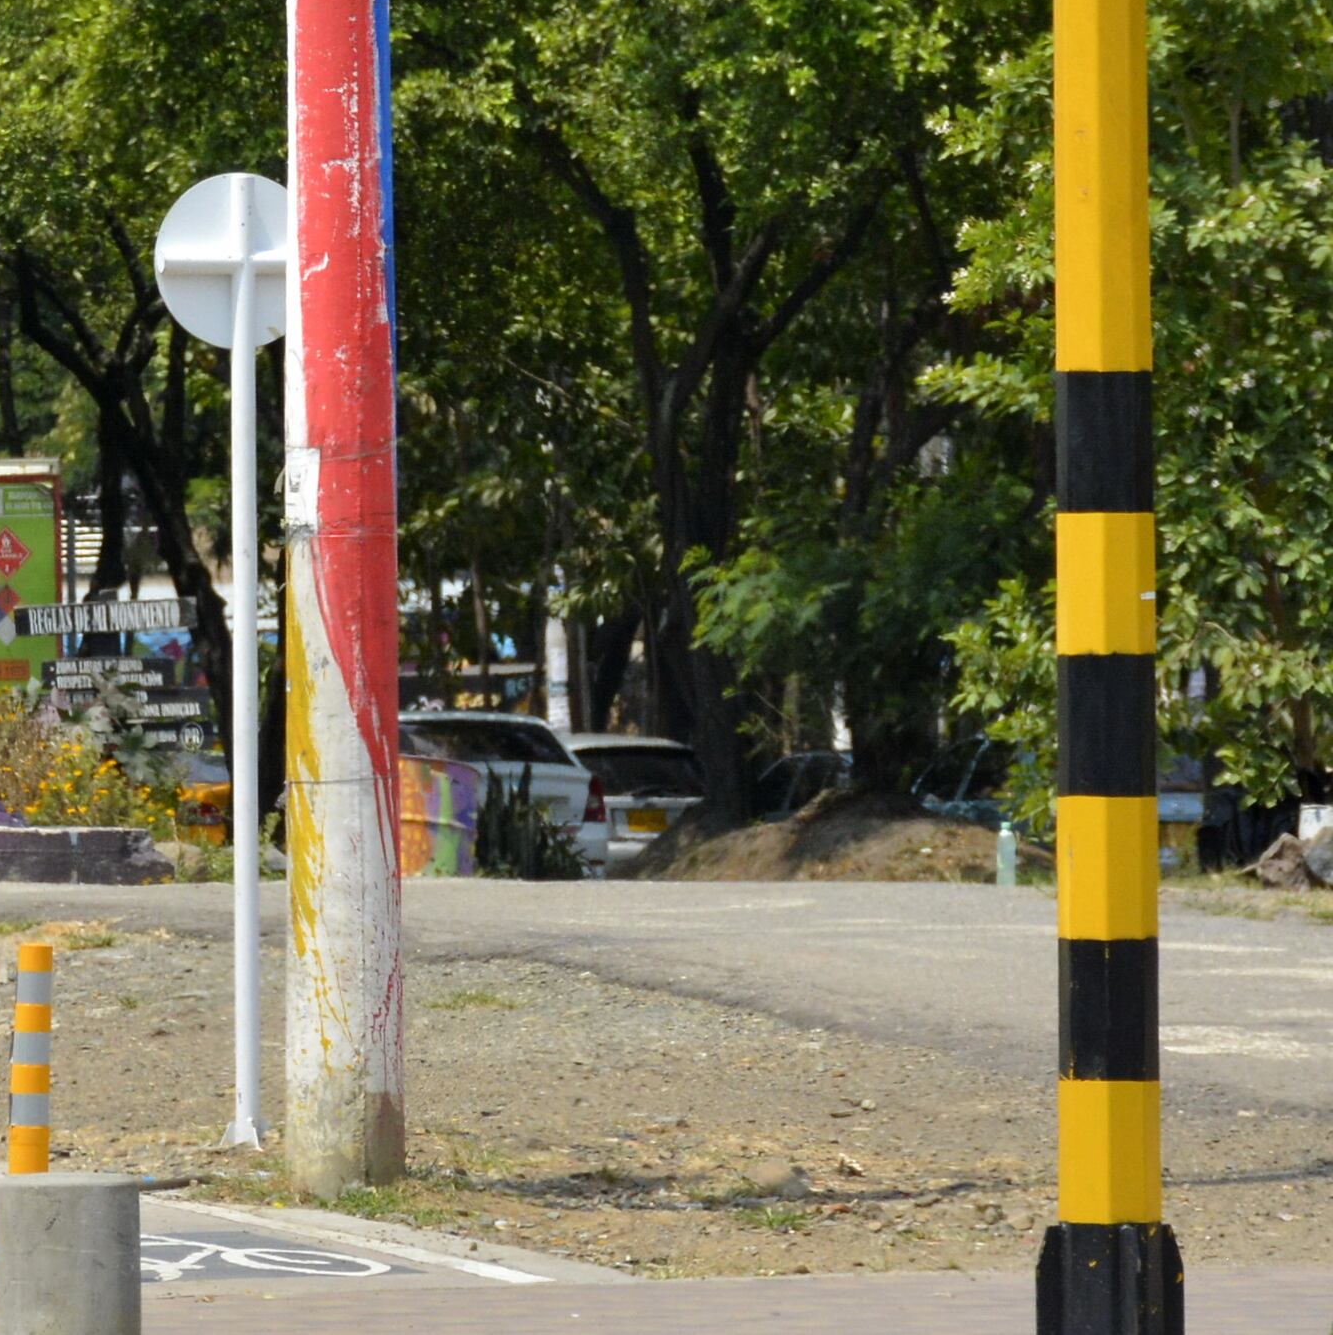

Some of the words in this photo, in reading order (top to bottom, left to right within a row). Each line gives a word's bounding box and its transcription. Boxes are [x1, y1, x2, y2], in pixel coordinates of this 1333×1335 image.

[29, 607, 72, 634] REGLAS
[75, 605, 91, 633] DE
[93, 604, 107, 632] MI
[109, 600, 181, 631] MONUMENTO
